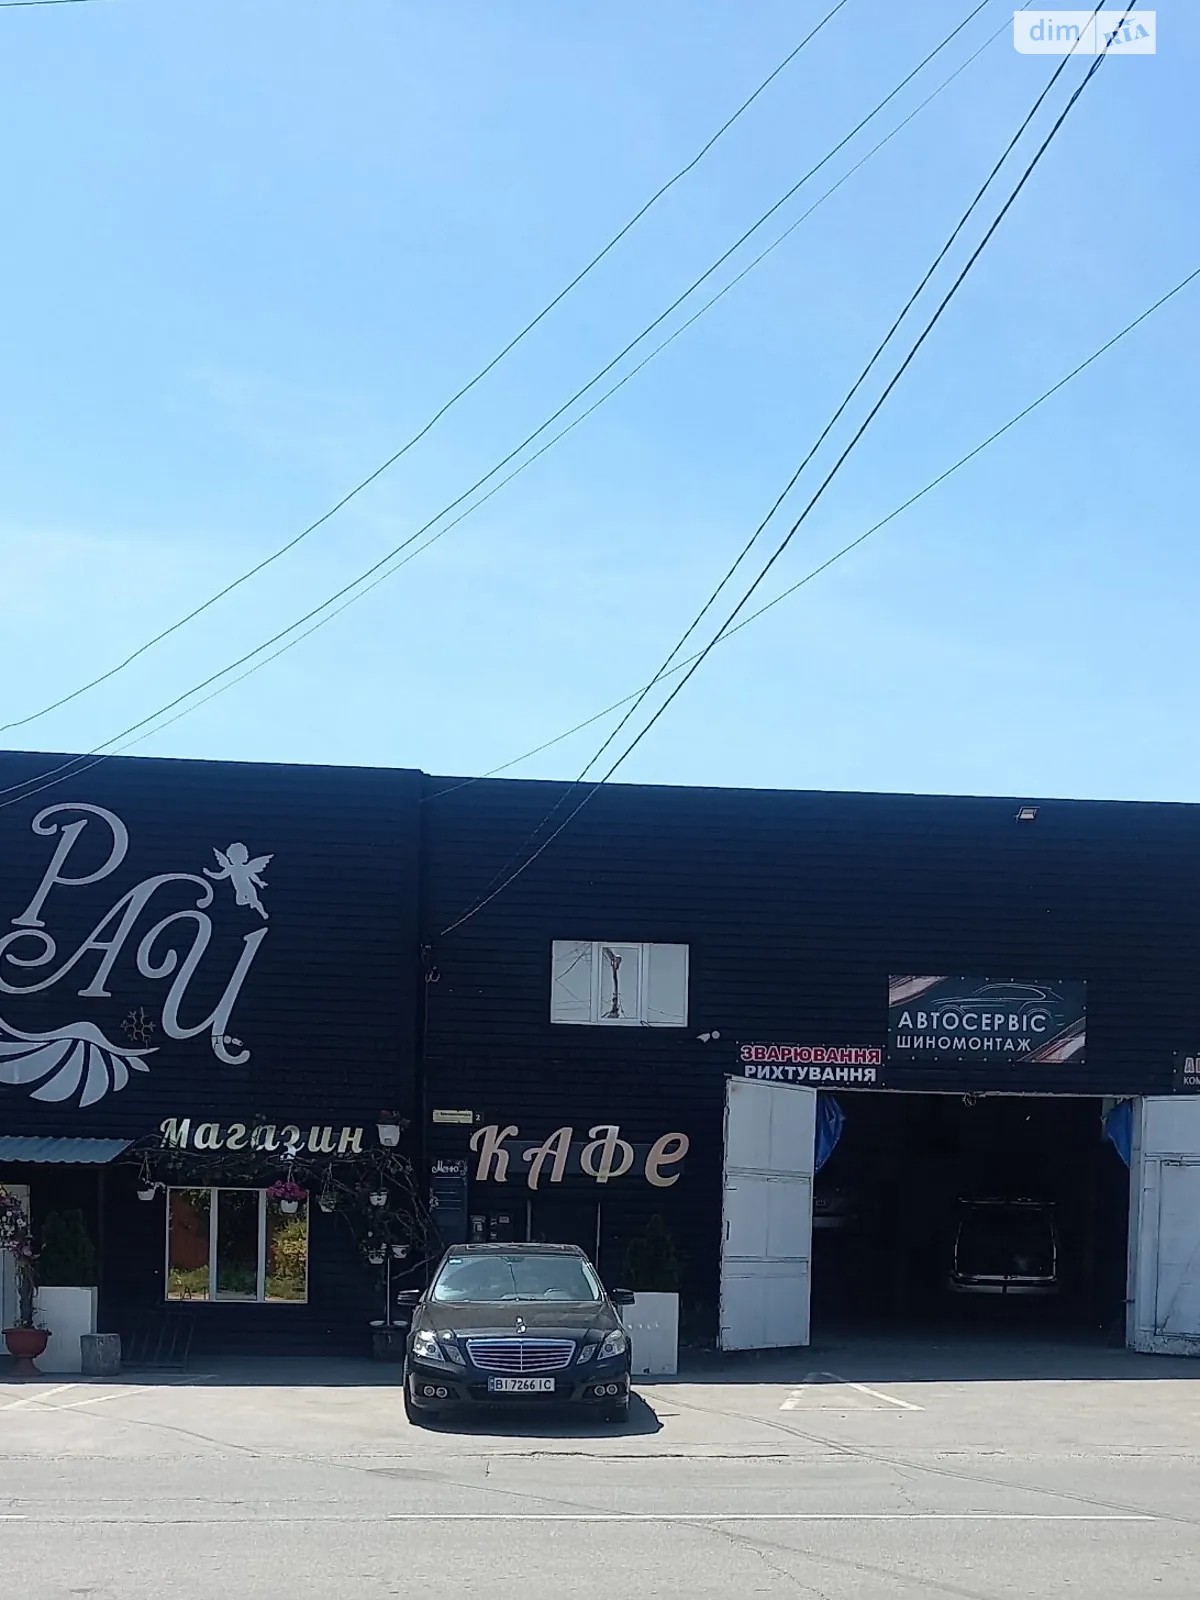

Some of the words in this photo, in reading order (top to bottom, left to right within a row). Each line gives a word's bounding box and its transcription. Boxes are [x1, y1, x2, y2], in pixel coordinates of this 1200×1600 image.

[897, 1010, 1047, 1033] АВТОСЕРВІС
[896, 1034, 1032, 1052] ШИНОМОНТАЖ
[740, 1045, 882, 1065] ЗВАРЮВАННЯ
[744, 1065, 877, 1082] РИХТУВАННЯ
[160, 1118, 364, 1155] Магазин
